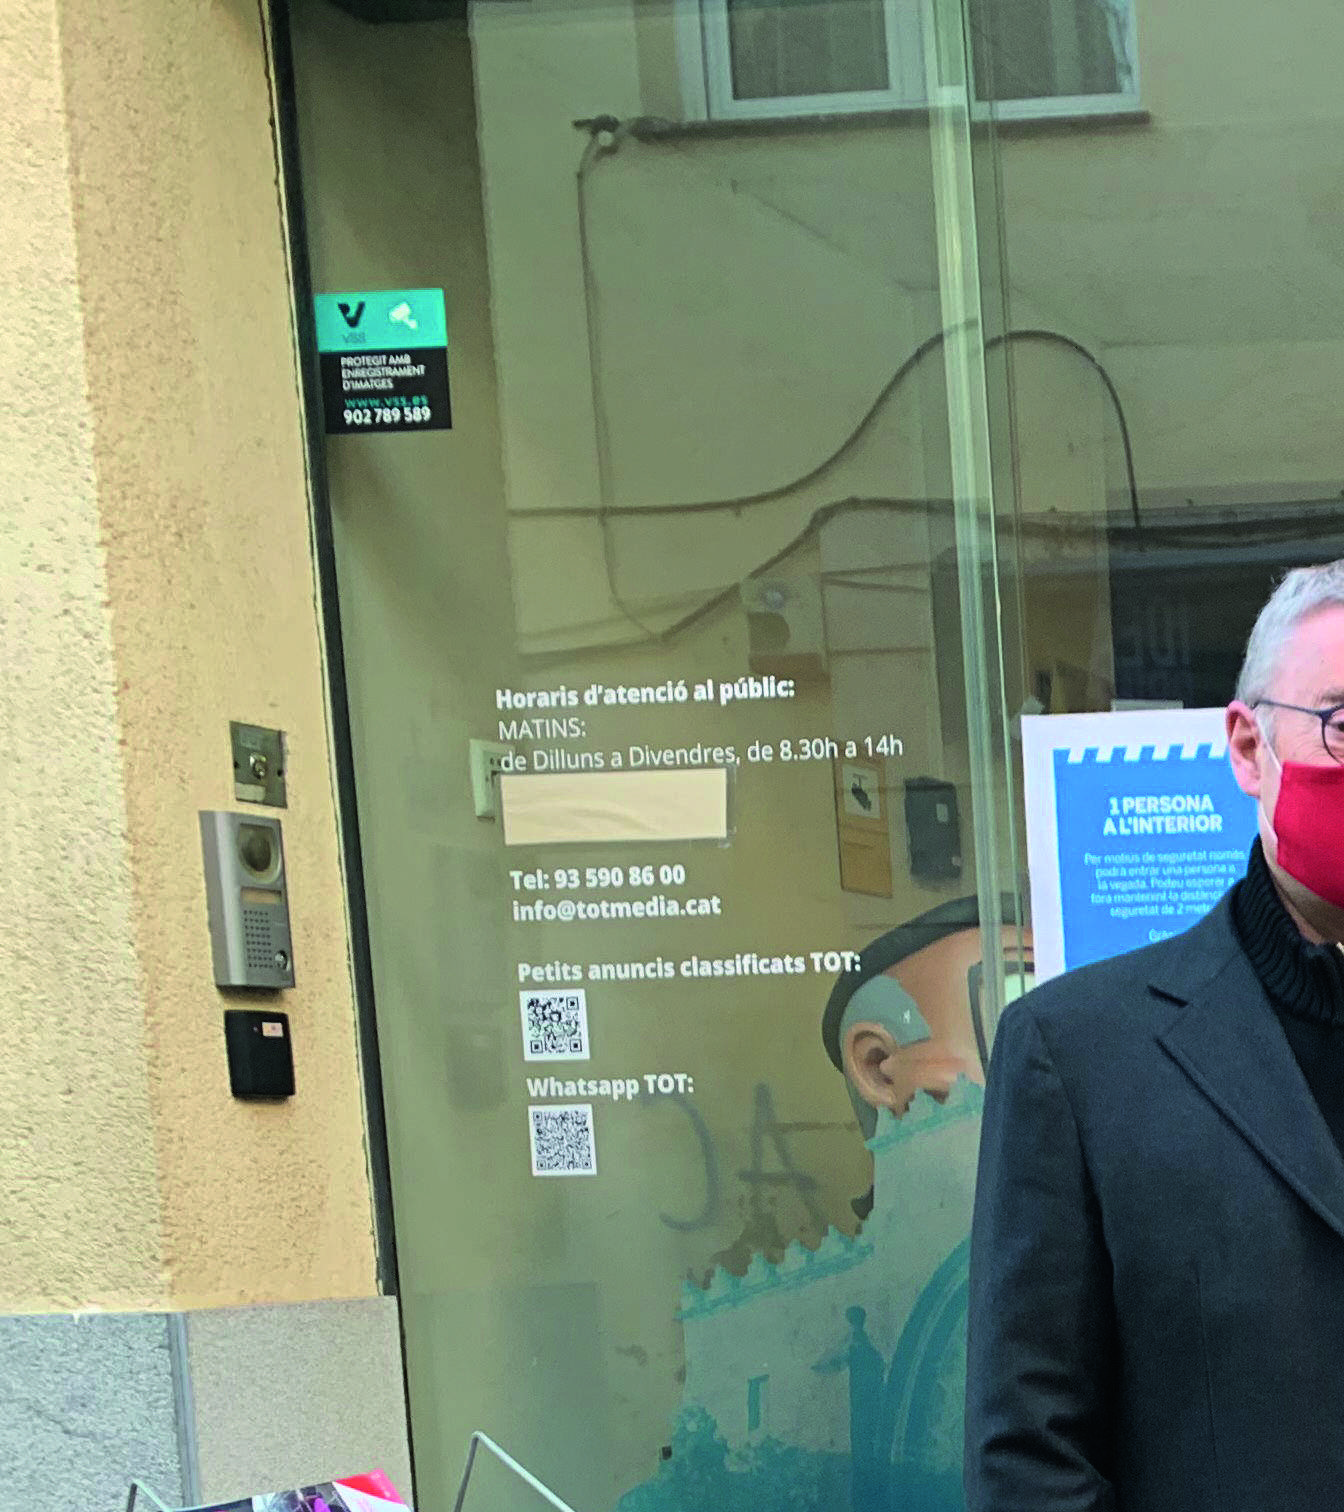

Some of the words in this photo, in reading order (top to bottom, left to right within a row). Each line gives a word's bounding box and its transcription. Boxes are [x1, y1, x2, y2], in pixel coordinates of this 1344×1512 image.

[340, 356, 388, 367] PROTEGIT
[389, 353, 411, 365] AMB
[342, 365, 426, 379] ENREGISTRAMENT
[343, 409, 372, 425] 902
[374, 408, 401, 423] 789
[403, 406, 432, 422] 589
[495, 685, 579, 710] Horaris
[584, 679, 689, 706] d'atenció
[693, 678, 715, 702] al
[719, 675, 795, 706] públic:
[498, 716, 586, 740] MATINS:
[499, 750, 528, 772] de
[531, 746, 606, 772] Dilluns
[610, 751, 623, 769] a
[628, 742, 742, 768] Divendres,
[747, 740, 774, 763] de
[779, 736, 839, 762] 8.30h
[844, 740, 857, 759] a
[864, 734, 903, 757] 14h
[1110, 797, 1120, 815] 1
[1123, 794, 1214, 814] PERSONA
[1103, 818, 1118, 836] A
[1120, 814, 1223, 835] L'INTERIOR
[509, 868, 550, 891] Tel:
[554, 868, 581, 889] 93
[585, 866, 624, 888] 590
[628, 865, 655, 887] 86
[659, 864, 686, 886] 00
[512, 894, 722, 922] info@totmedia.cat
[518, 960, 583, 983] Petits
[587, 957, 676, 981] anuncis
[679, 952, 806, 978] classificats
[809, 950, 861, 973] TOT:
[526, 1076, 640, 1101] Whatsapp
[643, 1073, 694, 1094] TOT:
